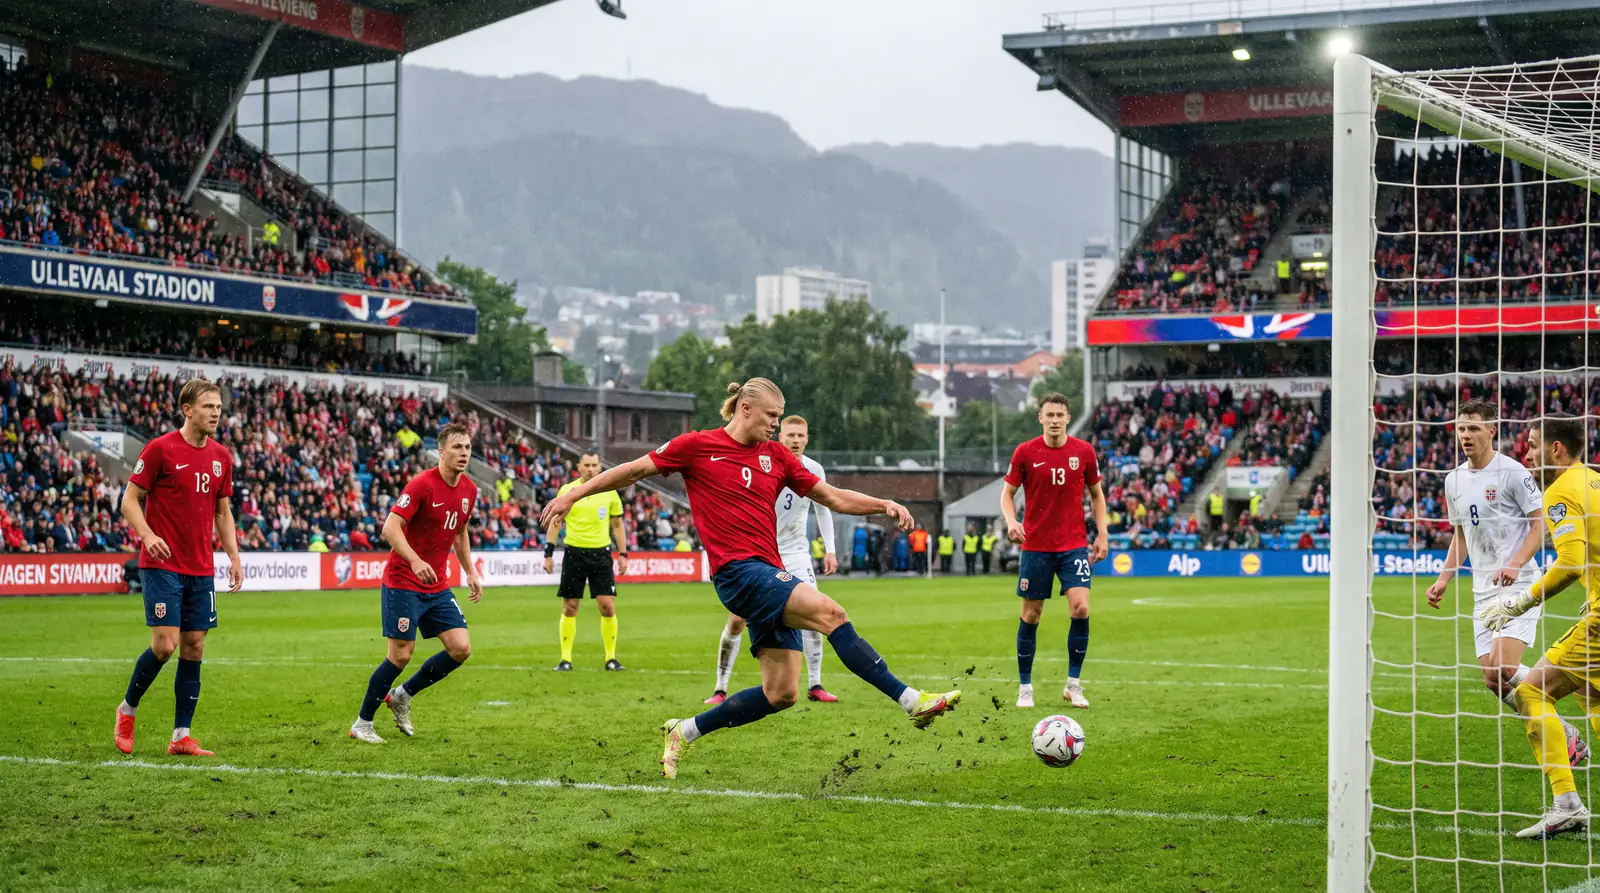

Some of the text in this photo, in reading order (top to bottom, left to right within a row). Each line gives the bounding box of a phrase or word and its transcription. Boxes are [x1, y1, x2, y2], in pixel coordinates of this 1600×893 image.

[1249, 91, 1332, 111] ULLEVAA
[31, 259, 215, 303] ULLEVAAL STADION
[741, 466, 752, 489] 9
[1050, 467, 1066, 486] 13
[783, 493, 793, 511] 3
[1470, 504, 1480, 527] 8
[50, 563, 126, 584] SIVAMXIR
[488, 559, 531, 577] Ullevaal
[1073, 559, 1091, 577] 23
[1383, 553, 1446, 574] Stadio
